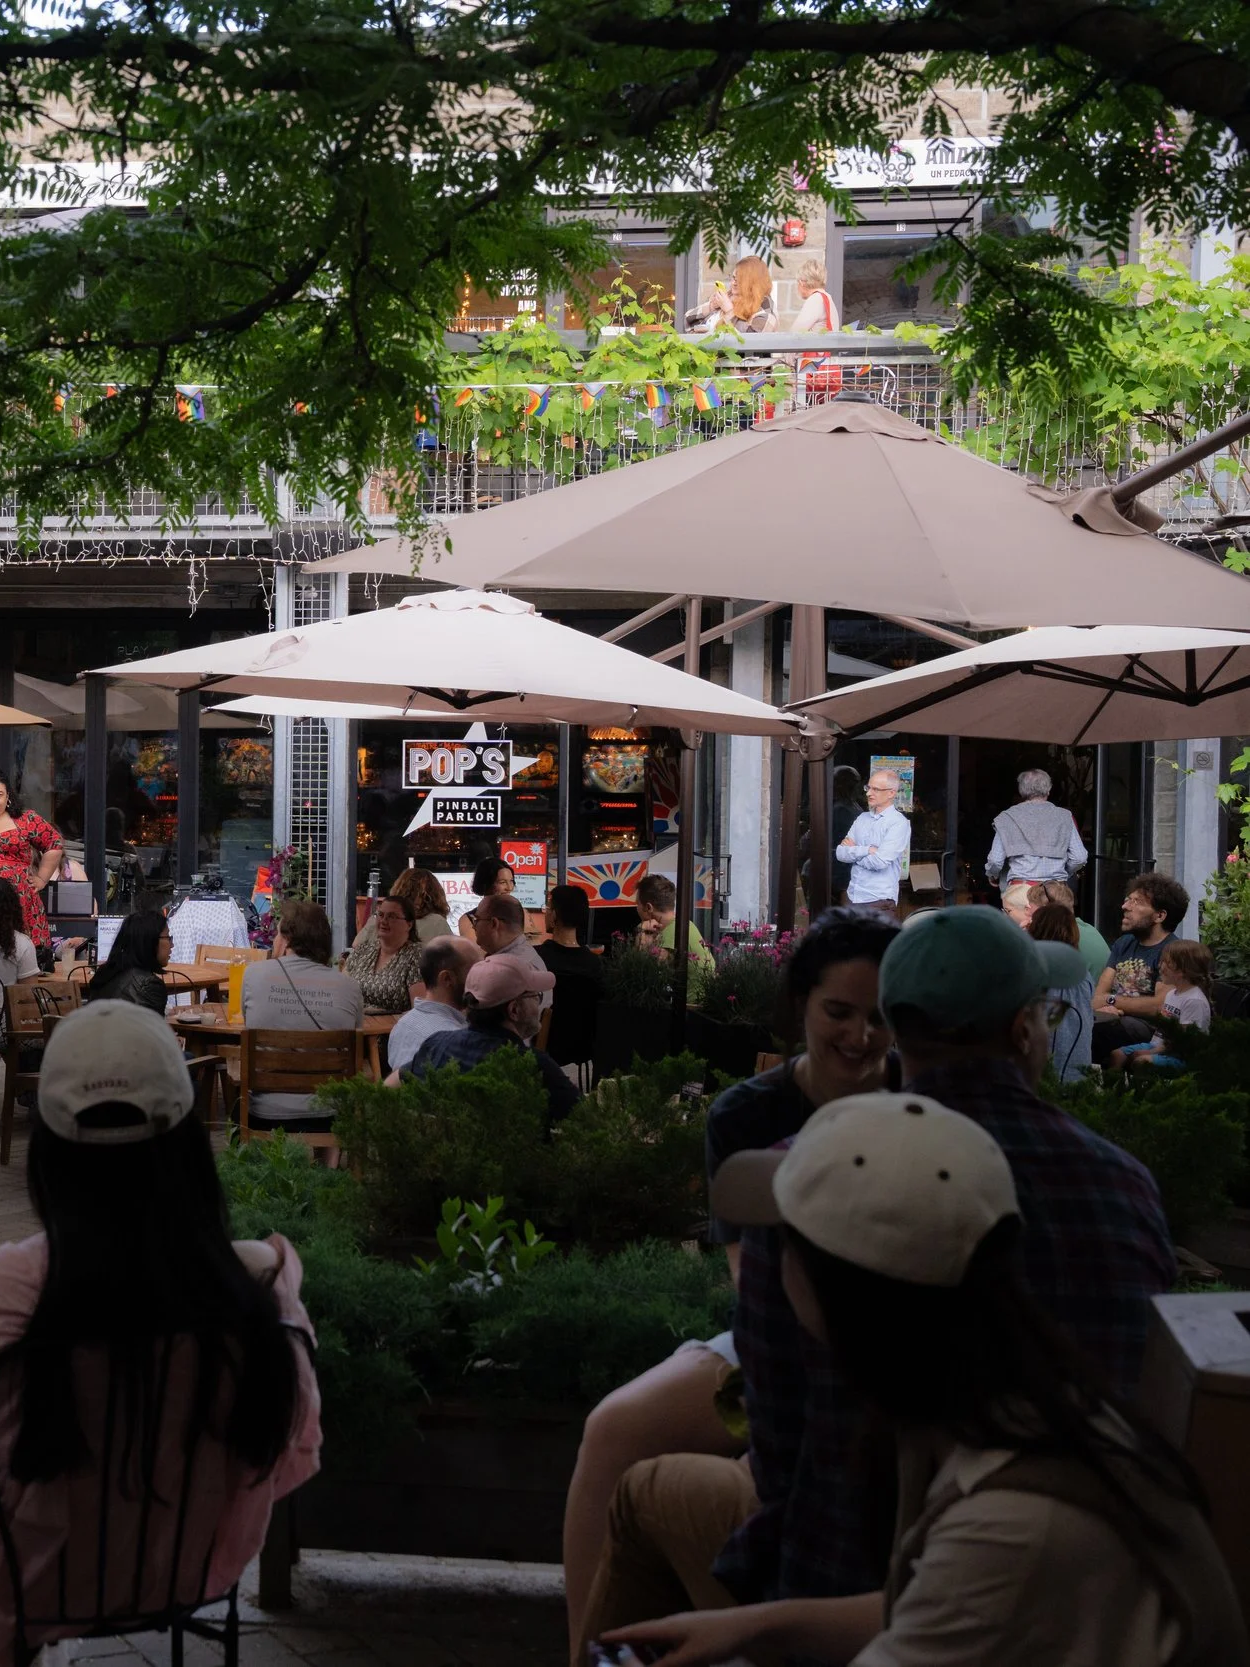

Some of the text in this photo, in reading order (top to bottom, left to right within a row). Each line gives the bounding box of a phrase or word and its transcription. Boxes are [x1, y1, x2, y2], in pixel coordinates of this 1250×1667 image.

[930, 170, 942, 178] UN
[117, 645, 149, 656] PLAY
[409, 746, 506, 784] POP'S
[436, 801, 495, 810] PINBALL
[436, 811, 495, 821] PARLOR
[504, 850, 543, 868] Open
[441, 880, 474, 895] BA
[318, 990, 331, 998] the
[268, 995, 301, 1005] freedom
[315, 1000, 333, 1008] read
[280, 1007, 301, 1016] since
